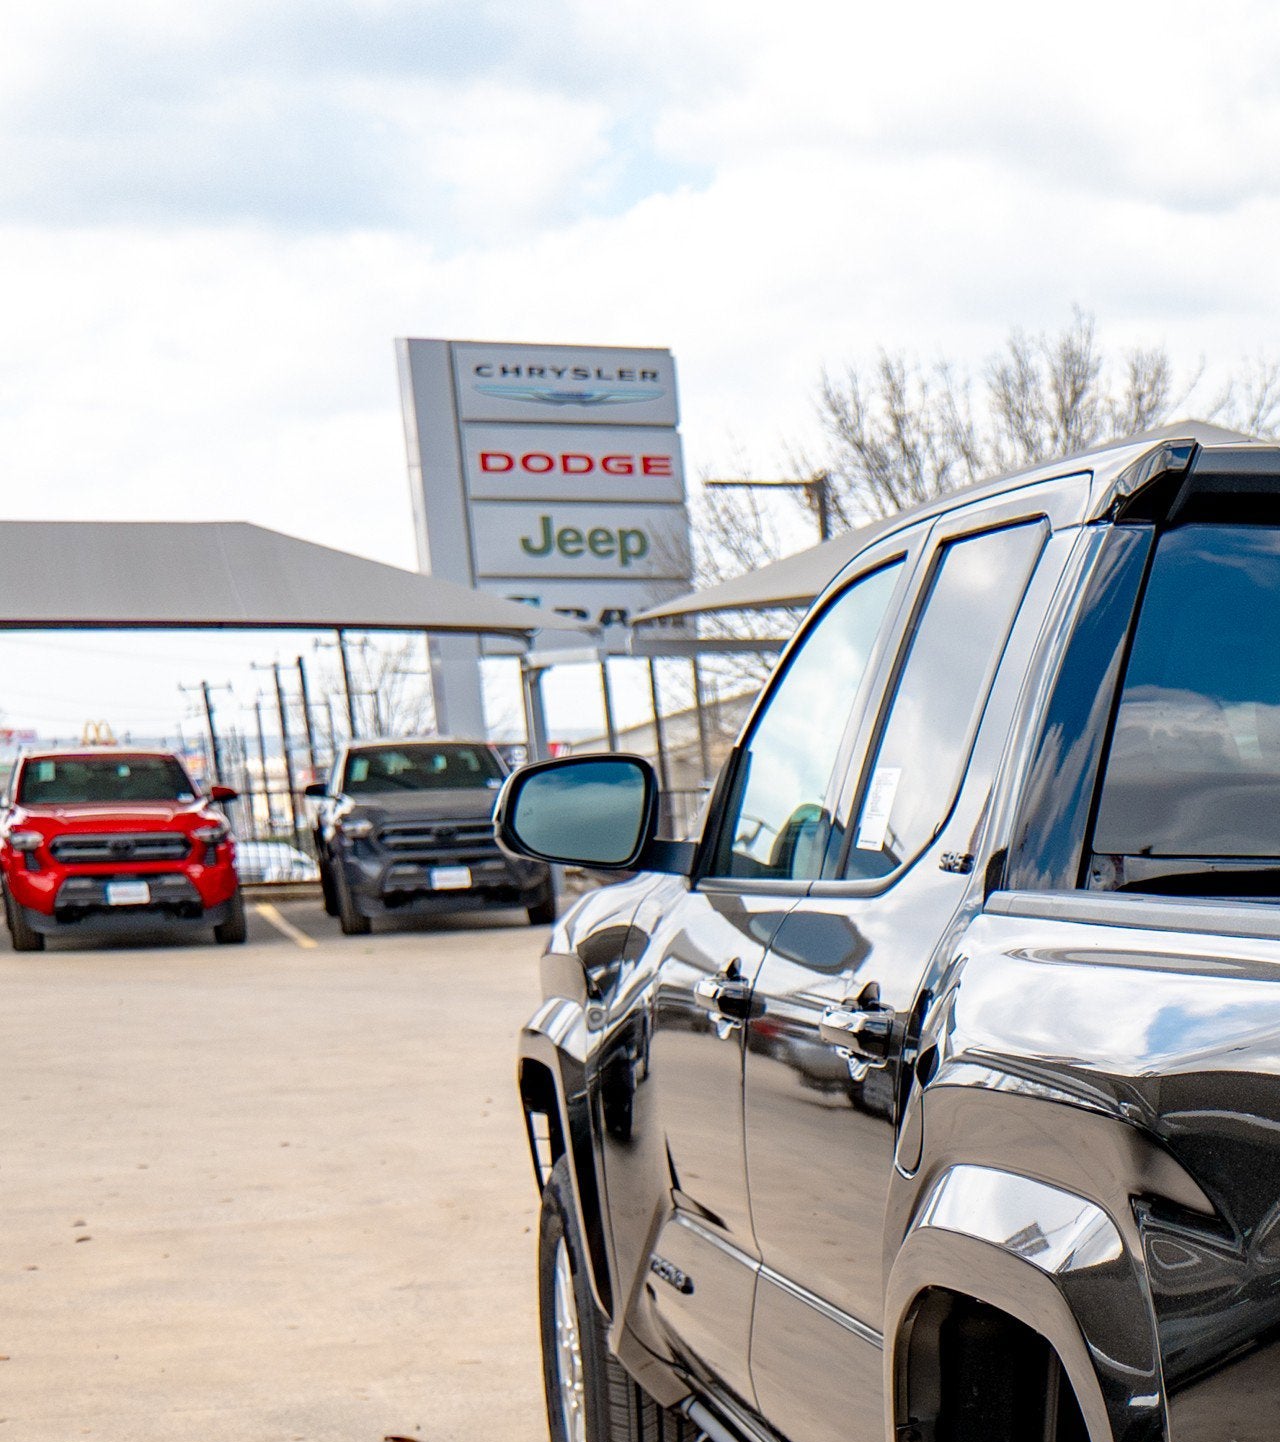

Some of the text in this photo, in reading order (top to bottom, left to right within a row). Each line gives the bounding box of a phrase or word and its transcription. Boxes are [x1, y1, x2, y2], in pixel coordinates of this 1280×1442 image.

[474, 363, 660, 383] CHRYSLER
[479, 451, 673, 477] DODGE
[520, 515, 648, 567] Jeep
